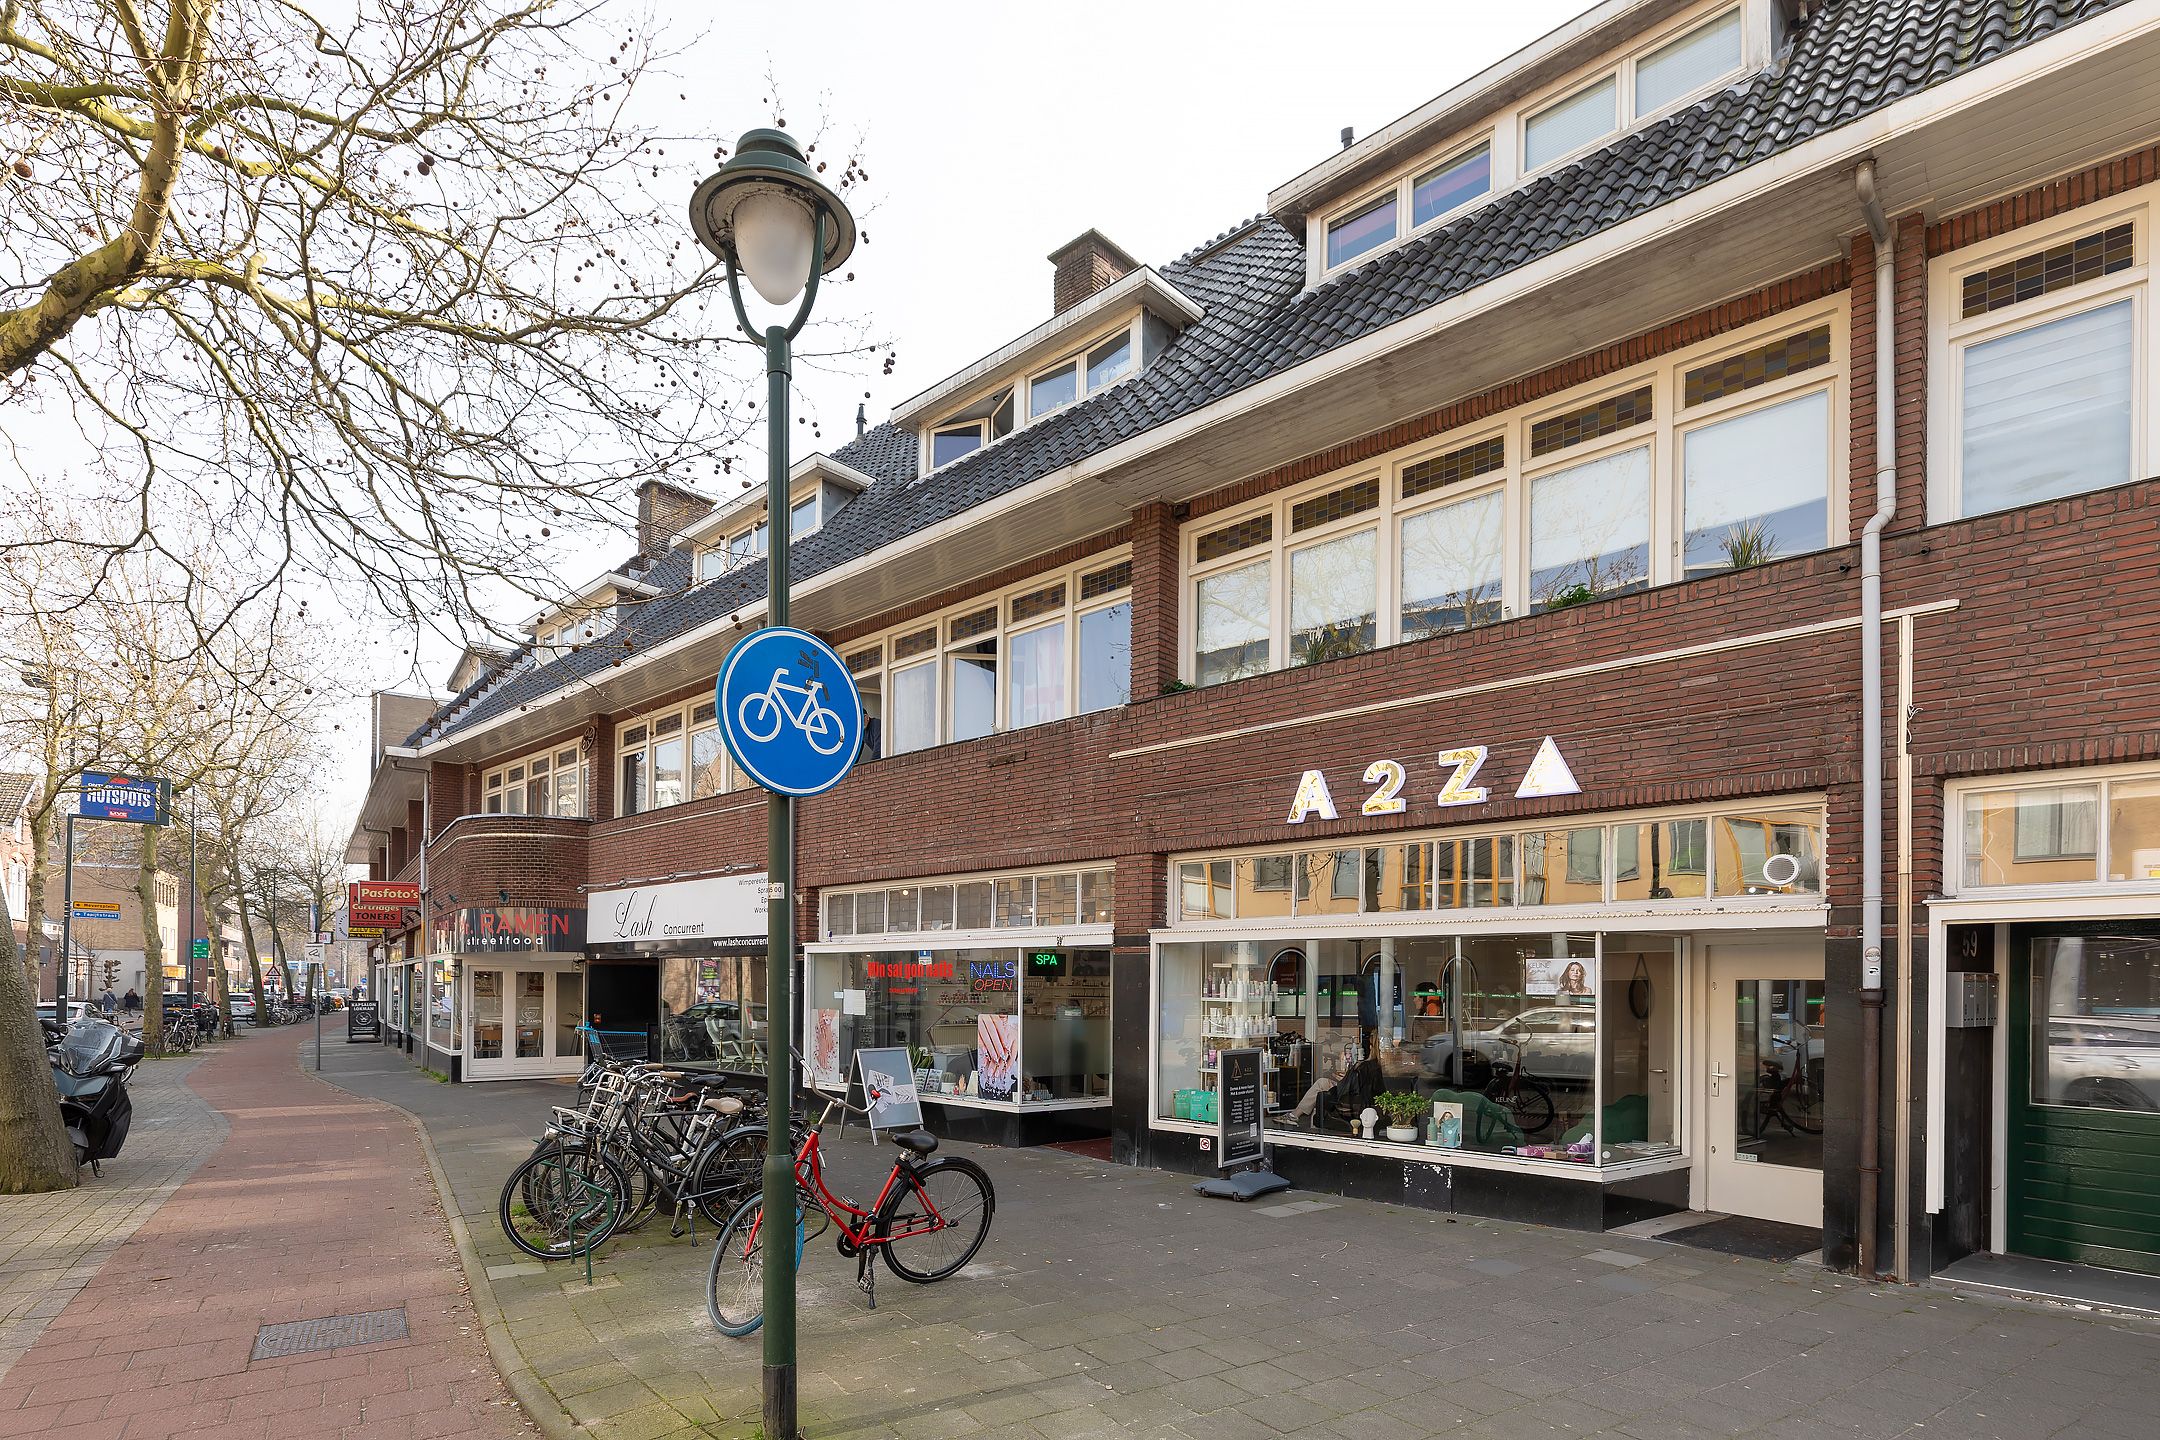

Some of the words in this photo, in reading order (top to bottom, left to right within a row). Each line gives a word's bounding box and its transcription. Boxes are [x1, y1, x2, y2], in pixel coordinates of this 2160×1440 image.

[1286, 745, 1489, 824] A2Z
[361, 888, 419, 899] Pasfoto's
[355, 912, 396, 920] TONERS
[613, 890, 658, 938] Lash
[663, 922, 705, 935] Concurrent
[480, 913, 569, 935] RAMEN
[466, 936, 543, 946] streetfood
[1962, 930, 1978, 957] 59
[1036, 954, 1058, 965] SPA
[970, 961, 1016, 978] NAILS
[974, 979, 1013, 991] OPEN
